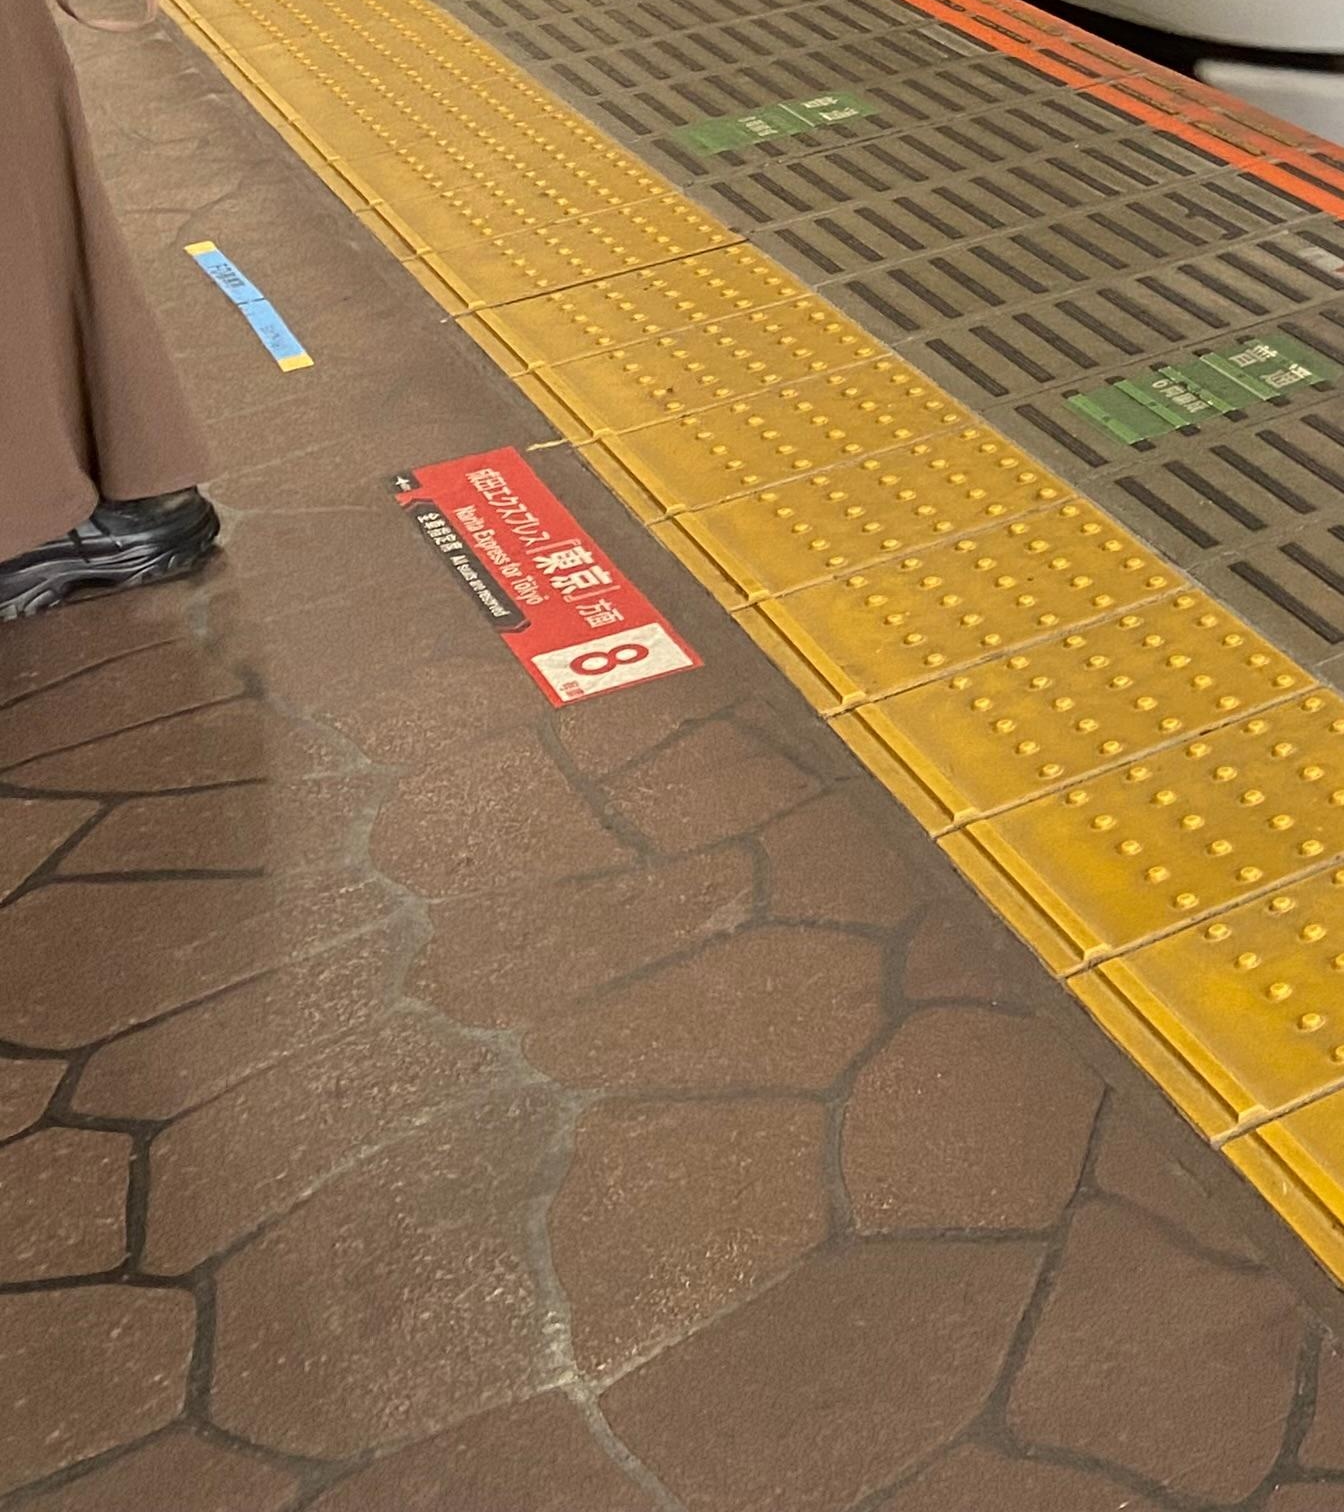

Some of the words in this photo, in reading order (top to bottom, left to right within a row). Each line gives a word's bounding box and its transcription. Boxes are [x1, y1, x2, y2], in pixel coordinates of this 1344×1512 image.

[1228, 345, 1312, 388] 普通
[472, 529, 511, 566] Express
[500, 562, 523, 578] for
[569, 642, 650, 676] 8
